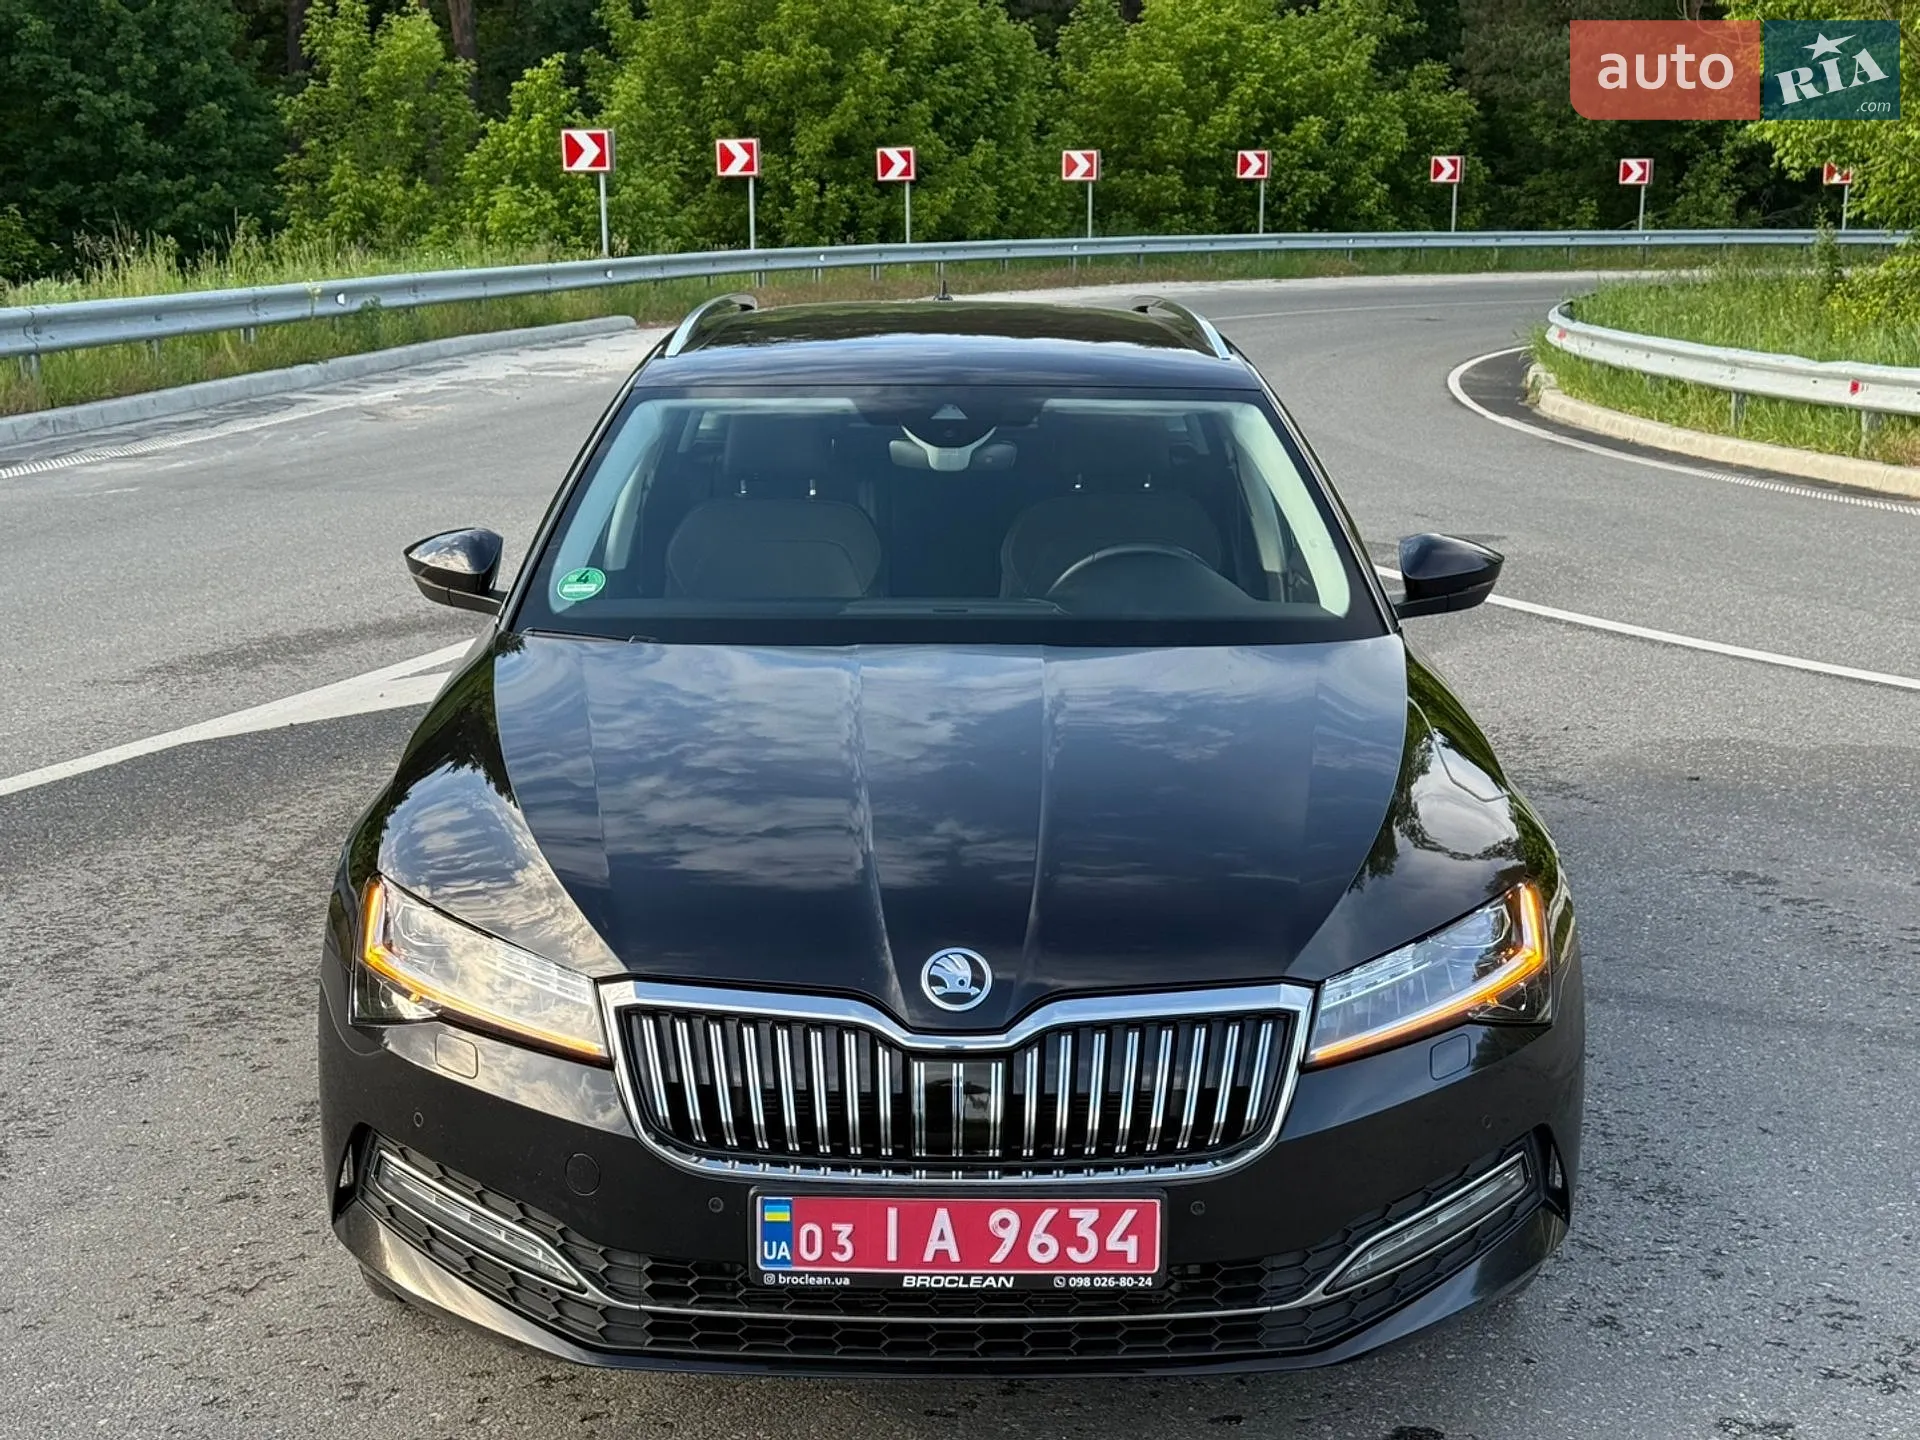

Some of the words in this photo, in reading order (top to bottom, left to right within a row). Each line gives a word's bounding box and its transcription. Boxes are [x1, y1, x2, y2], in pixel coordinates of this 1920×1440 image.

[575, 569, 590, 584] 4
[799, 1222, 855, 1263] 03
[988, 1208, 1139, 1264] 9634
[763, 1240, 792, 1260] UA
[778, 1273, 851, 1286] broclean.ua
[902, 1275, 1015, 1289] BROCLEAN
[1069, 1277, 1091, 1288] 098
[1093, 1277, 1153, 1288] 026-80-24
